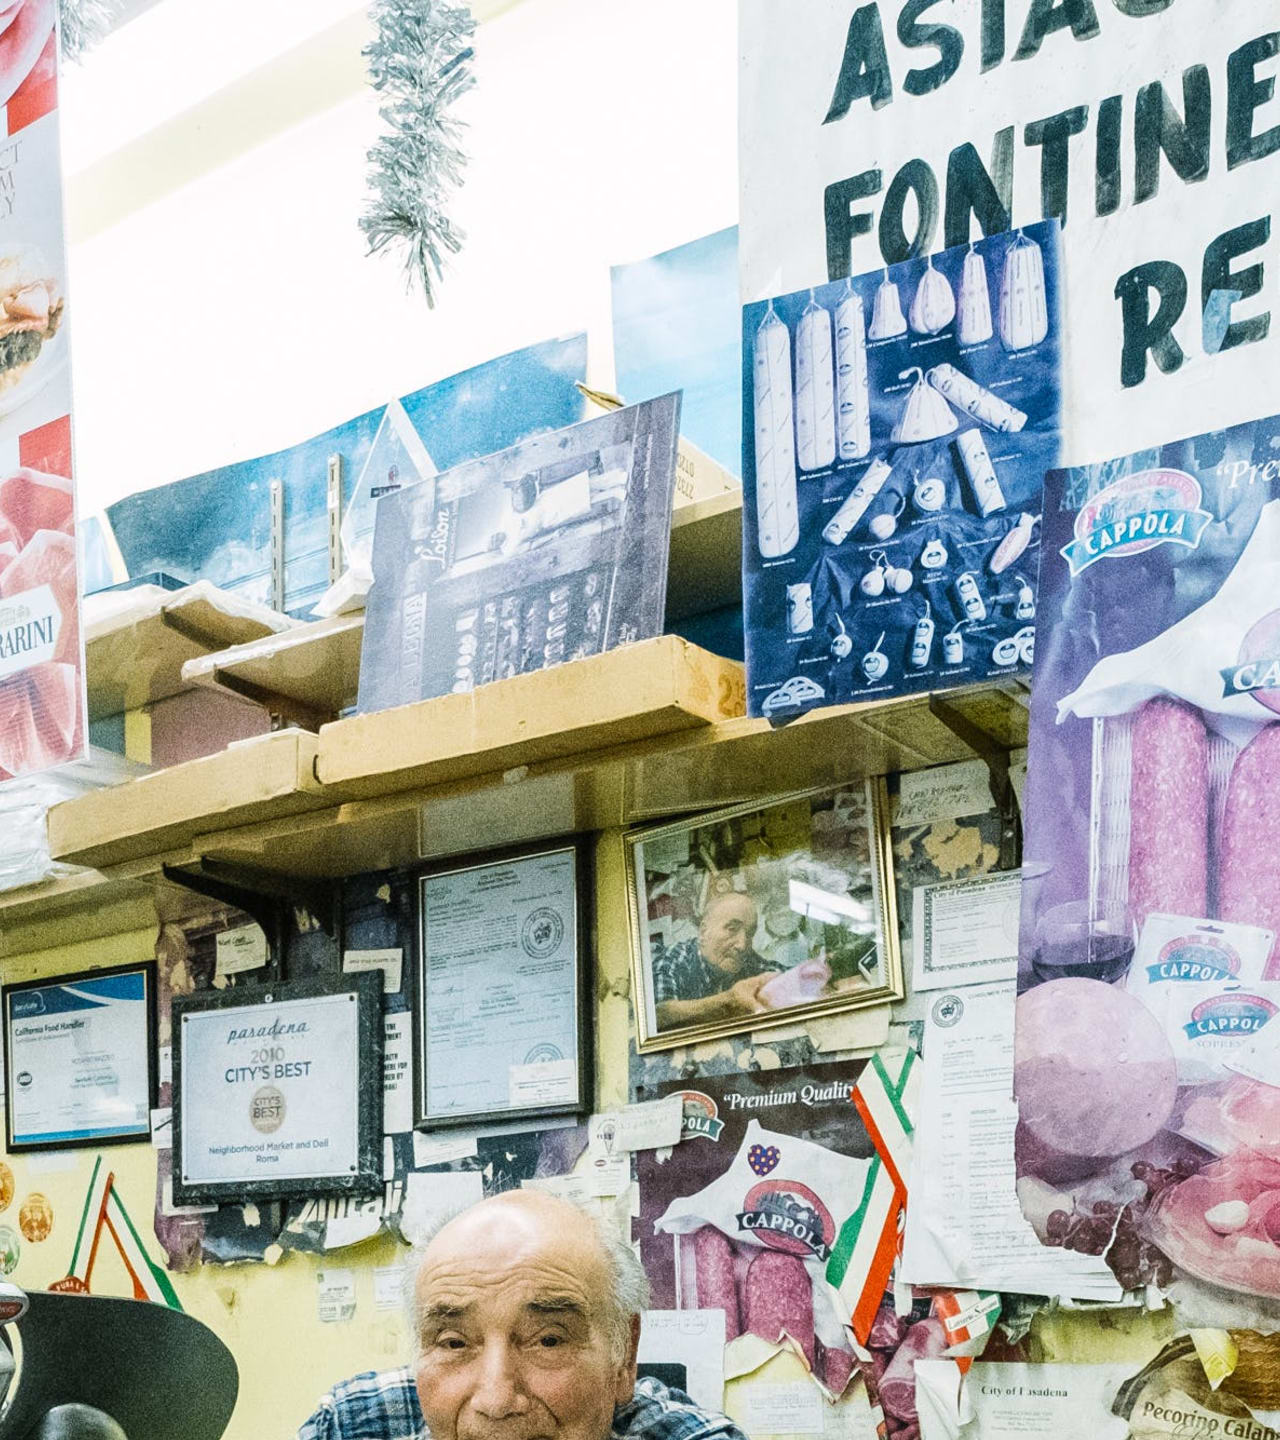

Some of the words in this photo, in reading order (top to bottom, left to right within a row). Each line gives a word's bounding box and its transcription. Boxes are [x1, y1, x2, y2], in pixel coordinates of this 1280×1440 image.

[823, 0, 1174, 125] ASIA
[414, 508, 450, 572] Loison
[1085, 513, 1186, 555] CAPPOLA
[227, 1015, 310, 1045] pasadena
[1197, 1016, 1261, 1033] CAPPOL
[275, 1061, 312, 1079] BEST
[801, 1081, 855, 1106] Quality
[253, 1105, 281, 1119] BEST
[209, 1143, 265, 1157] Neighborhood
[266, 1141, 294, 1151] Market
[295, 1140, 311, 1149] and
[256, 1155, 279, 1163] Roma
[742, 1212, 826, 1257] CAPPOLA
[982, 1385, 1003, 1398] City
[1143, 1401, 1220, 1433] Pecorino
